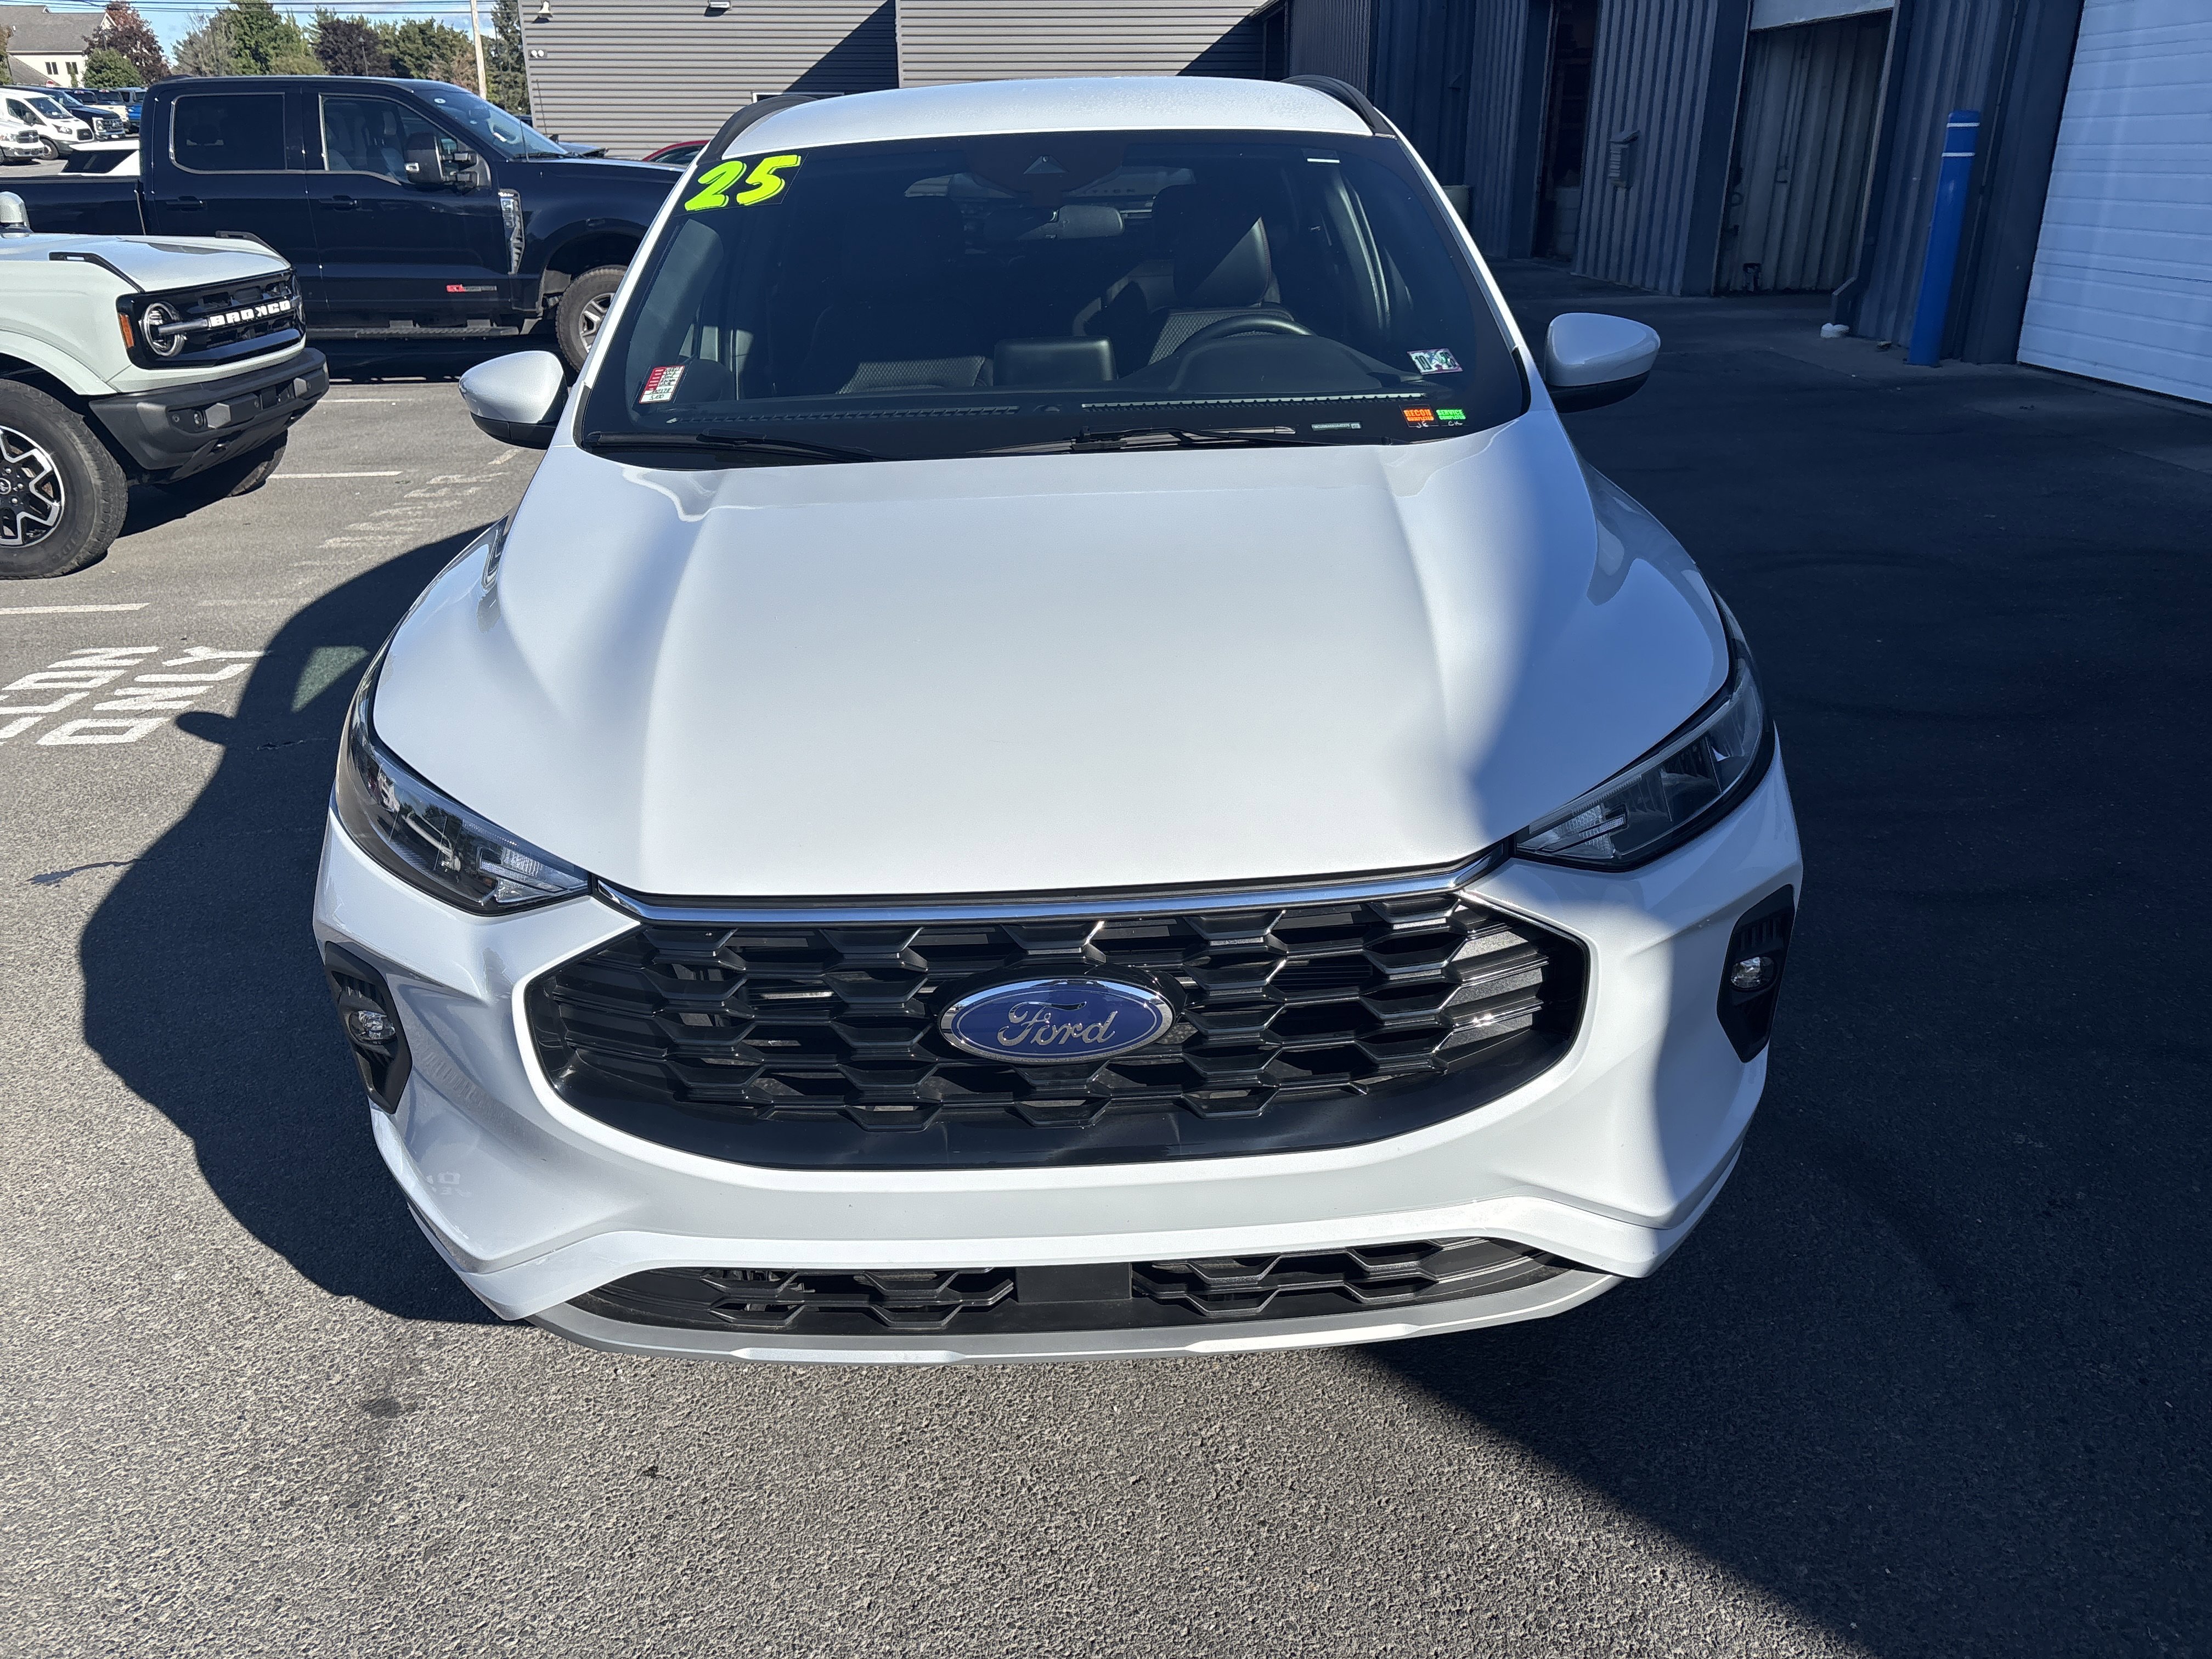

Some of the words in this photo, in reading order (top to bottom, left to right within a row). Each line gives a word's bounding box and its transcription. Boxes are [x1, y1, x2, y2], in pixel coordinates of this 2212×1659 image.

[685, 155, 802, 212] 25
[209, 300, 291, 327] BRONCO
[1403, 409, 1432, 417] RECON
[36, 646, 268, 746] ONLY
[997, 1001, 1118, 1047] Ford
